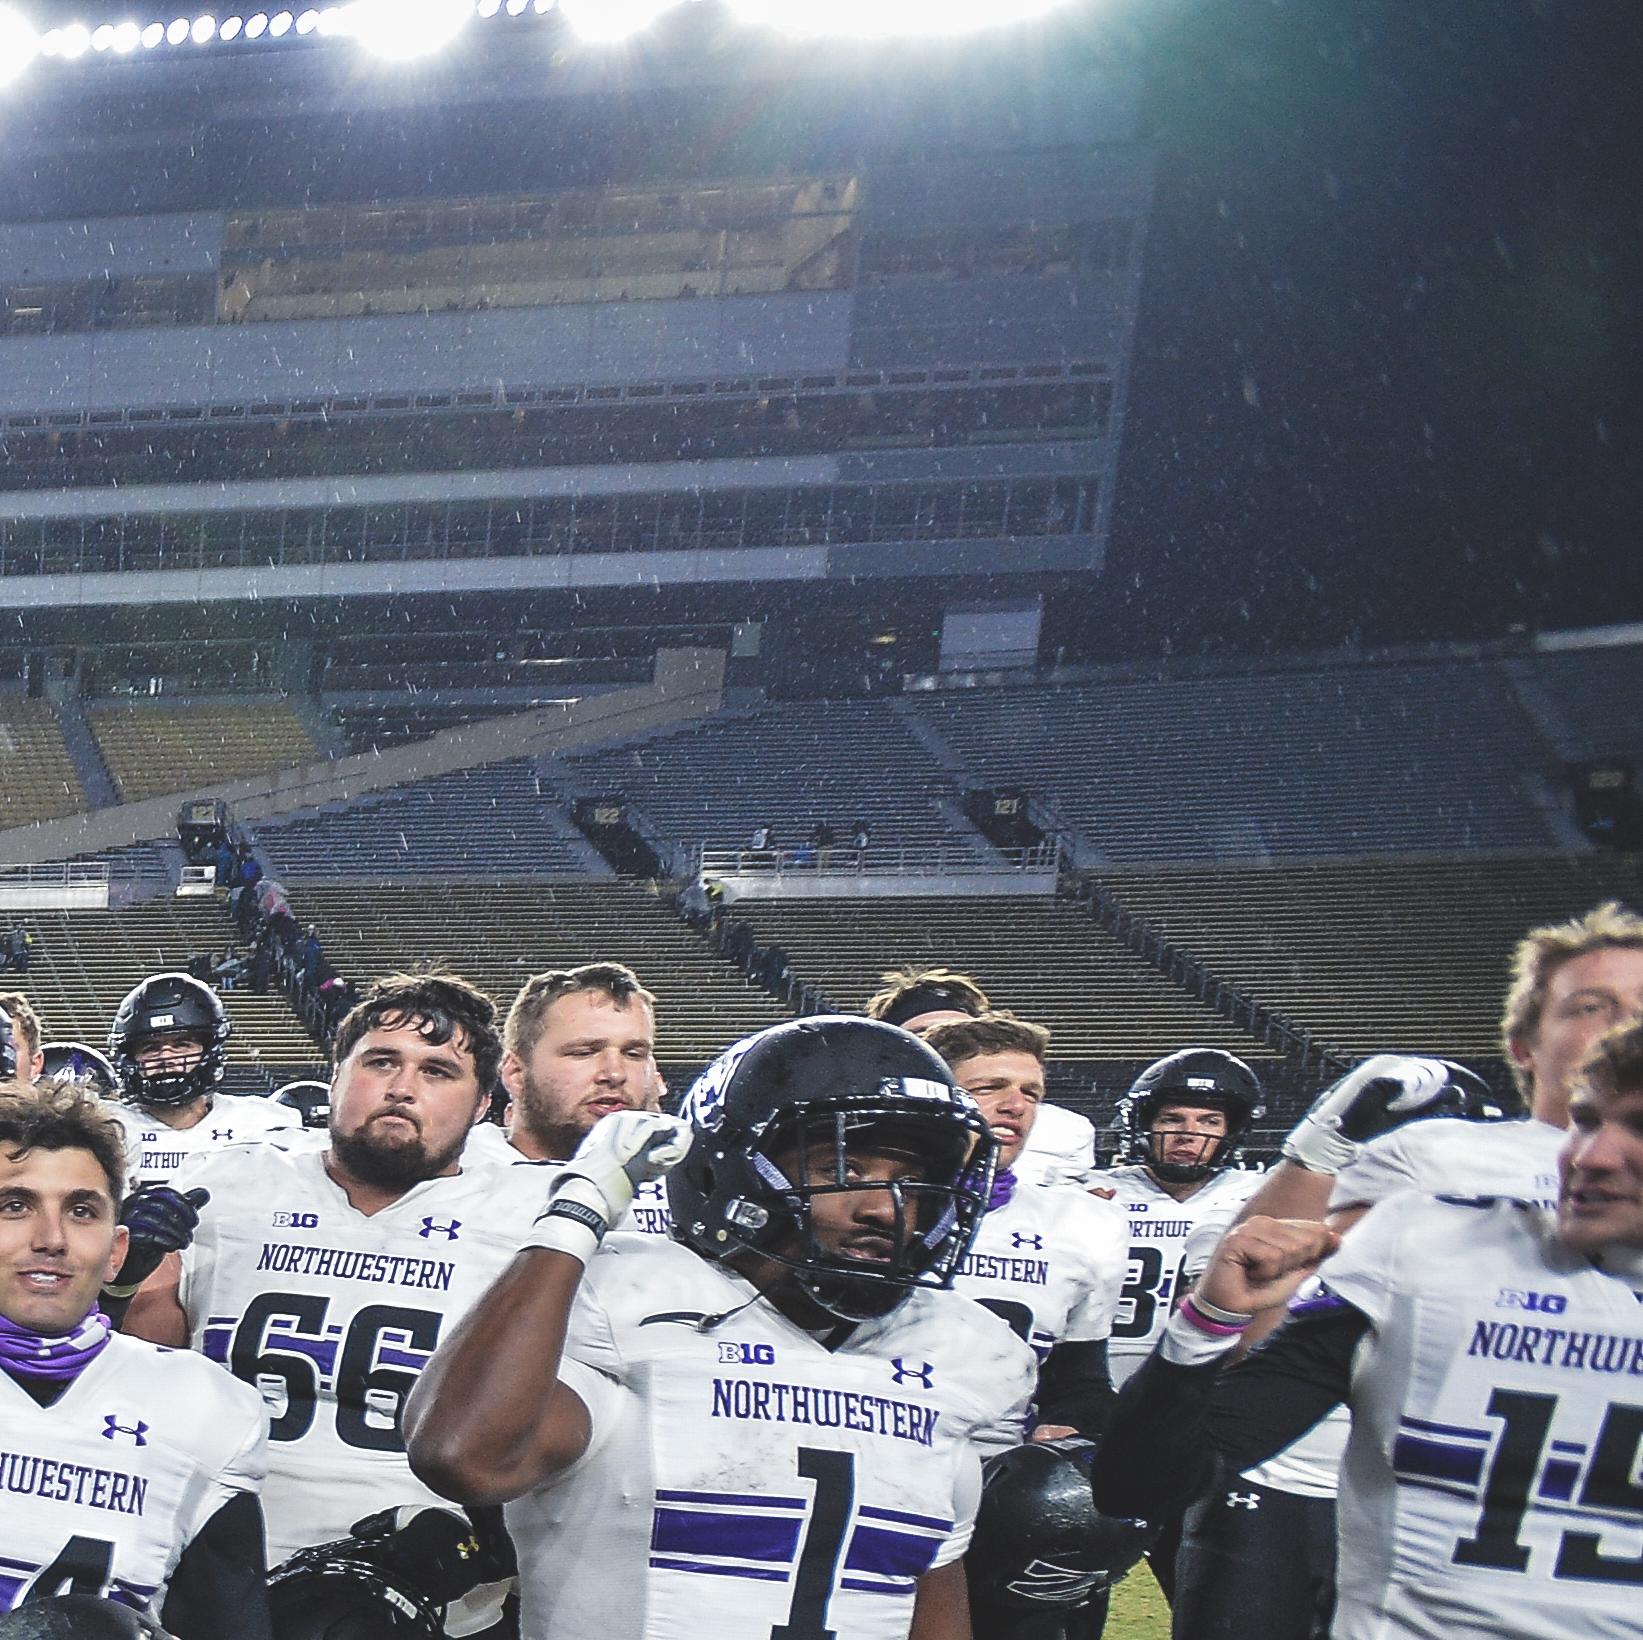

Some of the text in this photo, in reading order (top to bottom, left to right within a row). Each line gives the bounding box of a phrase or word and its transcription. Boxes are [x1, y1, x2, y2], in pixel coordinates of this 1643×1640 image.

[257, 1242, 454, 1292] NORTHWESTERN
[232, 1294, 442, 1452] 66
[712, 1379, 939, 1446] NORTHWESTERN
